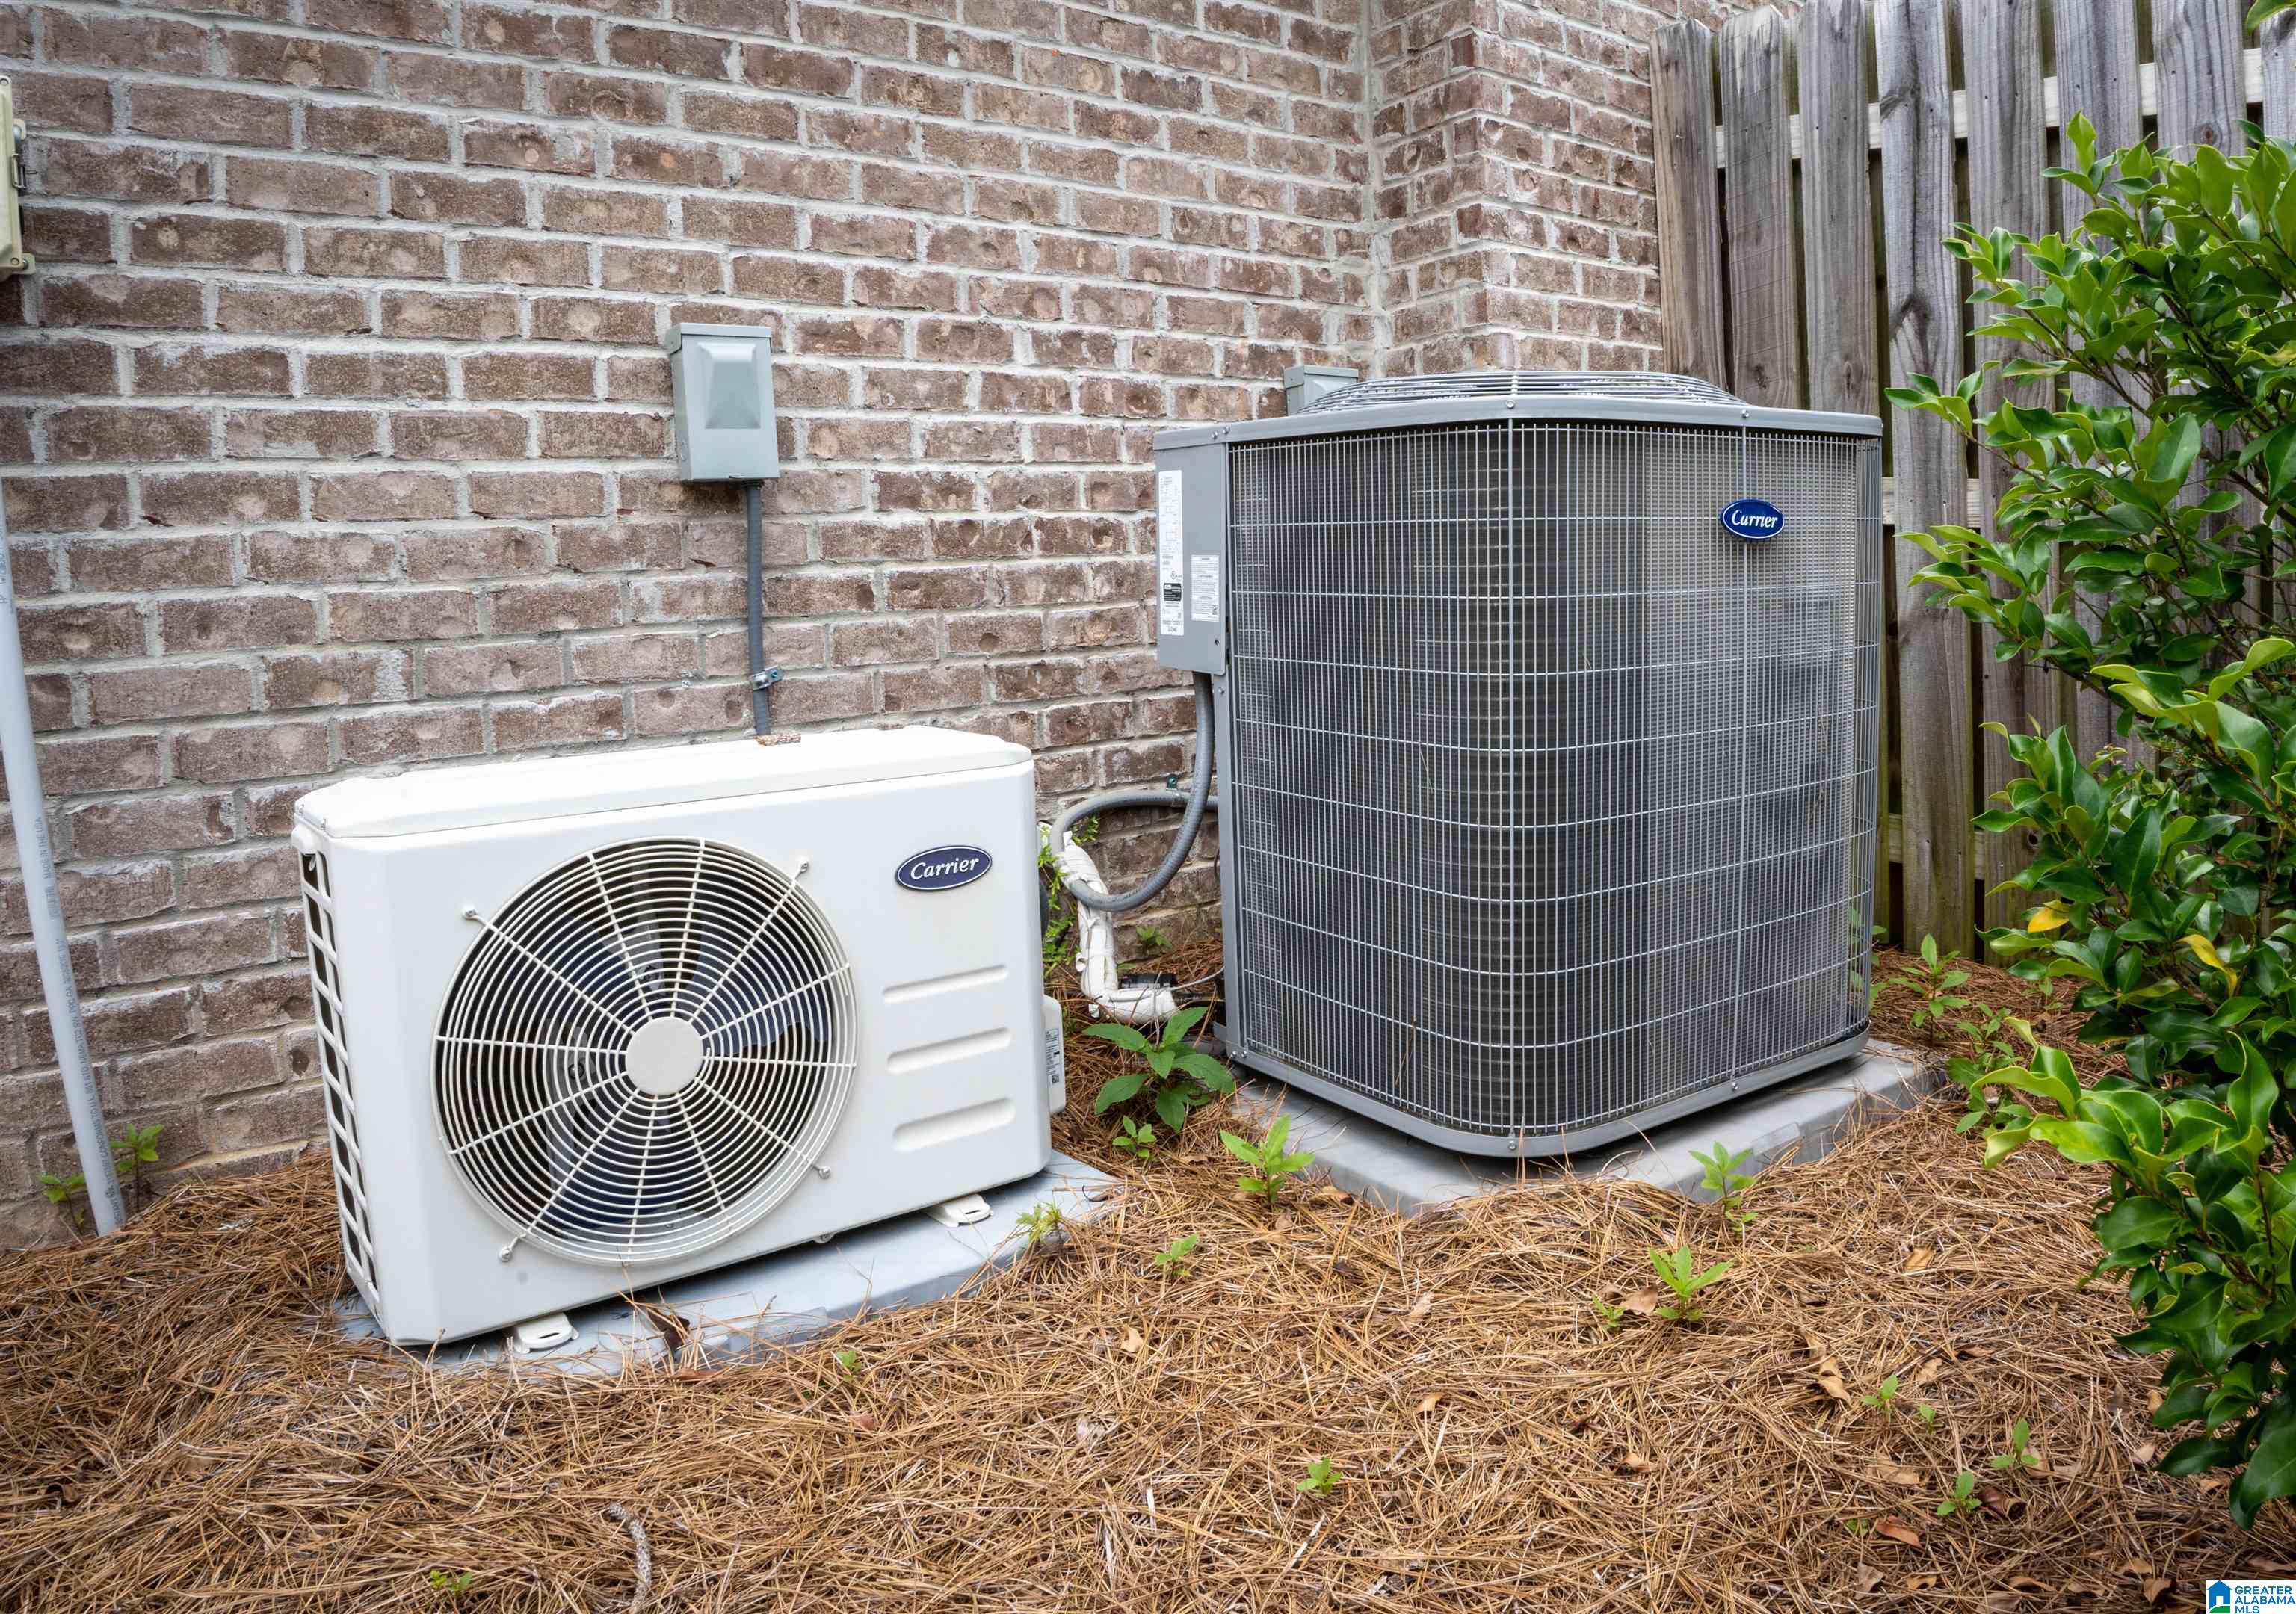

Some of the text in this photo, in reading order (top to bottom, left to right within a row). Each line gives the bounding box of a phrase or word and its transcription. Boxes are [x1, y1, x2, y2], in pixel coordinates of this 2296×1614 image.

[1731, 509, 1778, 528] Carrier
[35, 834, 46, 849] THE
[910, 858, 979, 879] Carrier
